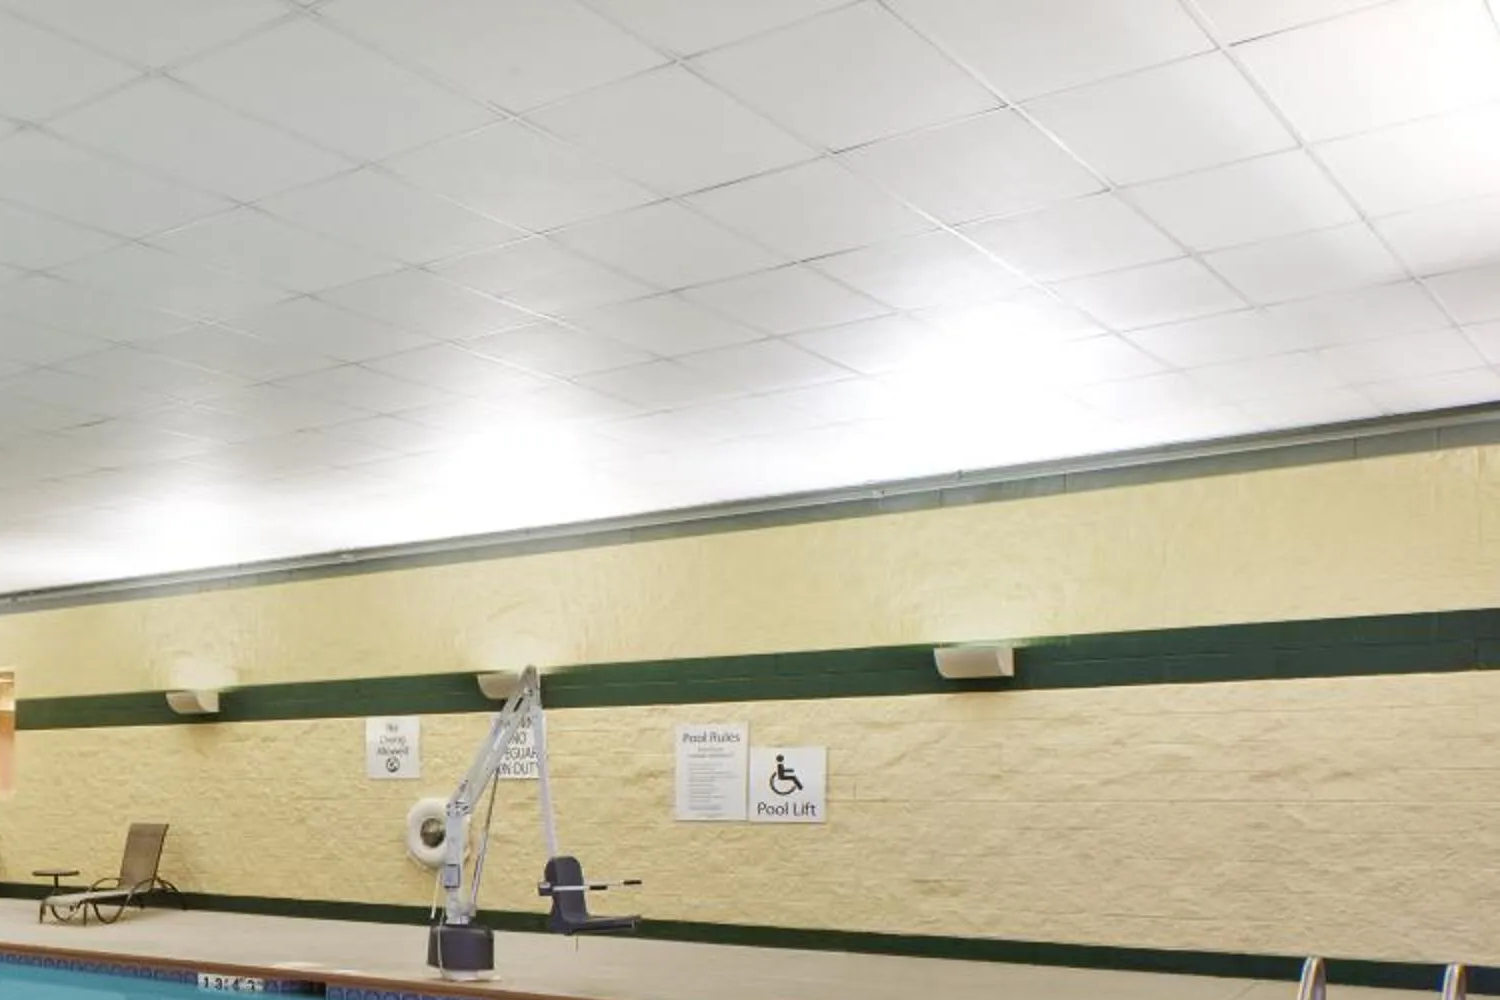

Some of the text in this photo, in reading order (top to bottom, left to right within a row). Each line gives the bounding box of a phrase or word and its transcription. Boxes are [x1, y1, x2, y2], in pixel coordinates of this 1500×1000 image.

[682, 730, 741, 743] Pool Rules
[757, 801, 817, 817] Pool Lift
